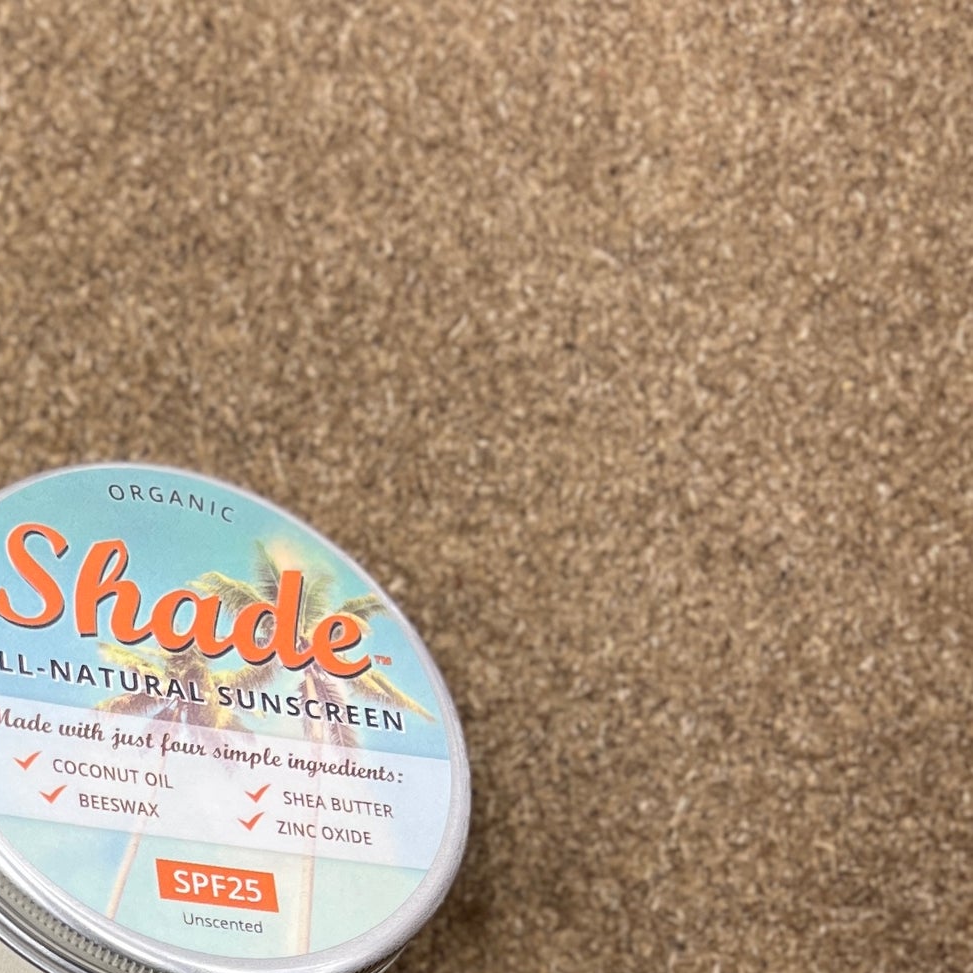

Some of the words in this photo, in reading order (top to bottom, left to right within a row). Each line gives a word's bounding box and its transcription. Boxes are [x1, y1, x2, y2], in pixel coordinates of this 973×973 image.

[108, 483, 235, 523] ORGANIC
[218, 685, 406, 733] SUNSCREEN
[58, 722, 104, 743] with
[110, 727, 155, 751] just
[160, 732, 207, 758] four
[212, 742, 281, 770] simple
[287, 752, 404, 785] ingredients:
[52, 758, 139, 786] COCONUT
[144, 770, 174, 790] OIL
[78, 793, 160, 818] BEESWAX
[283, 791, 326, 811] SHEA
[331, 795, 395, 820] BUTTER
[276, 820, 317, 839] ZINC
[322, 826, 373, 846] OXIDE
[173, 870, 263, 903] SPF25
[183, 912, 264, 935] Unscented
